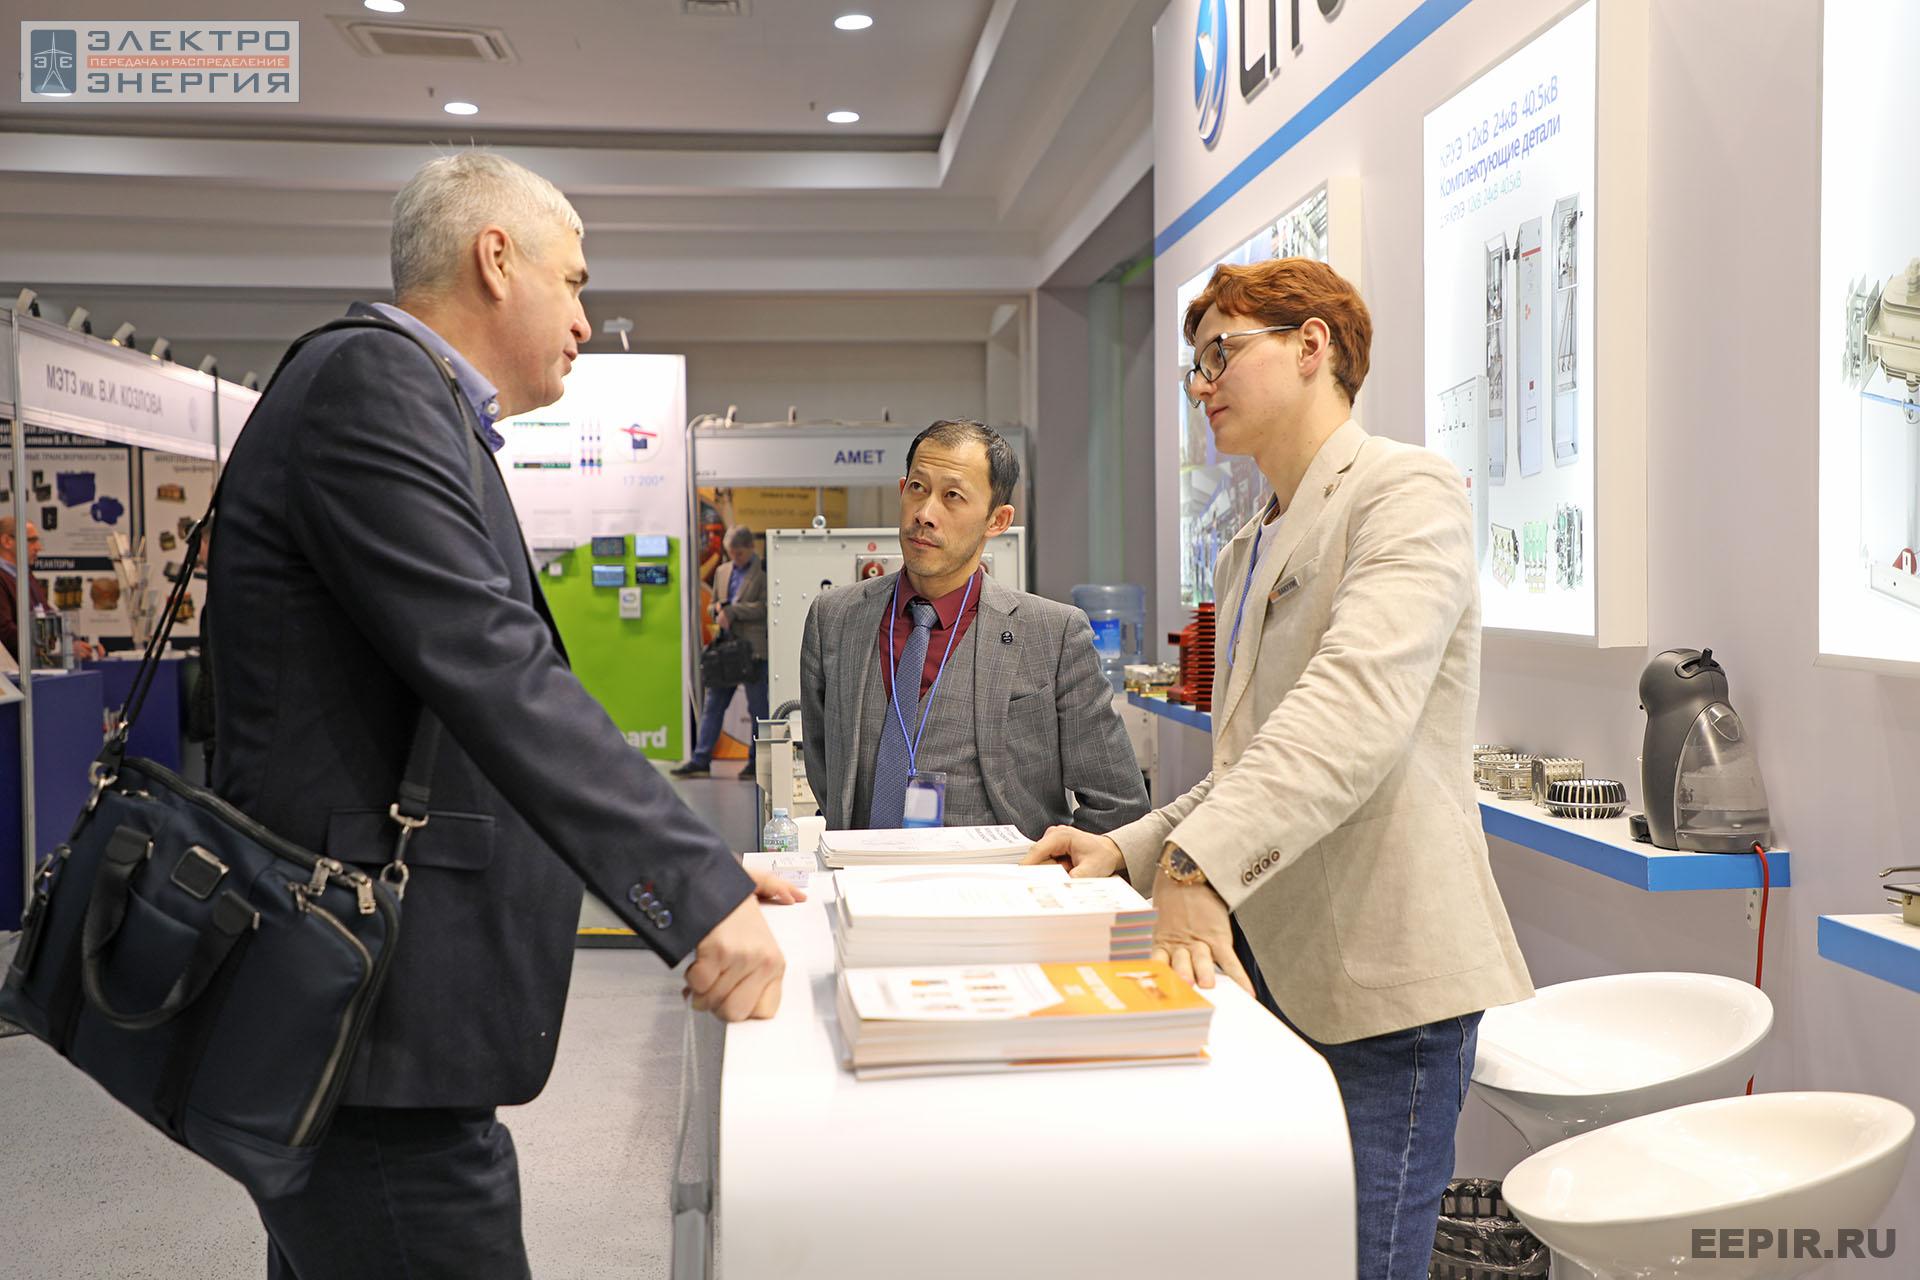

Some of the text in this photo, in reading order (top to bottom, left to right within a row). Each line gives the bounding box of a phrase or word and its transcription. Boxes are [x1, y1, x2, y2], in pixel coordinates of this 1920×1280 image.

[1467, 120, 1489, 152] 12кВ
[1493, 101, 1518, 138] 24кВ
[1522, 75, 1558, 119] 40.5кВ
[1440, 114, 1561, 199] Комплектующие детали
[46, 364, 163, 416] МЭТЗ им. В.И. КОЗЛОВА
